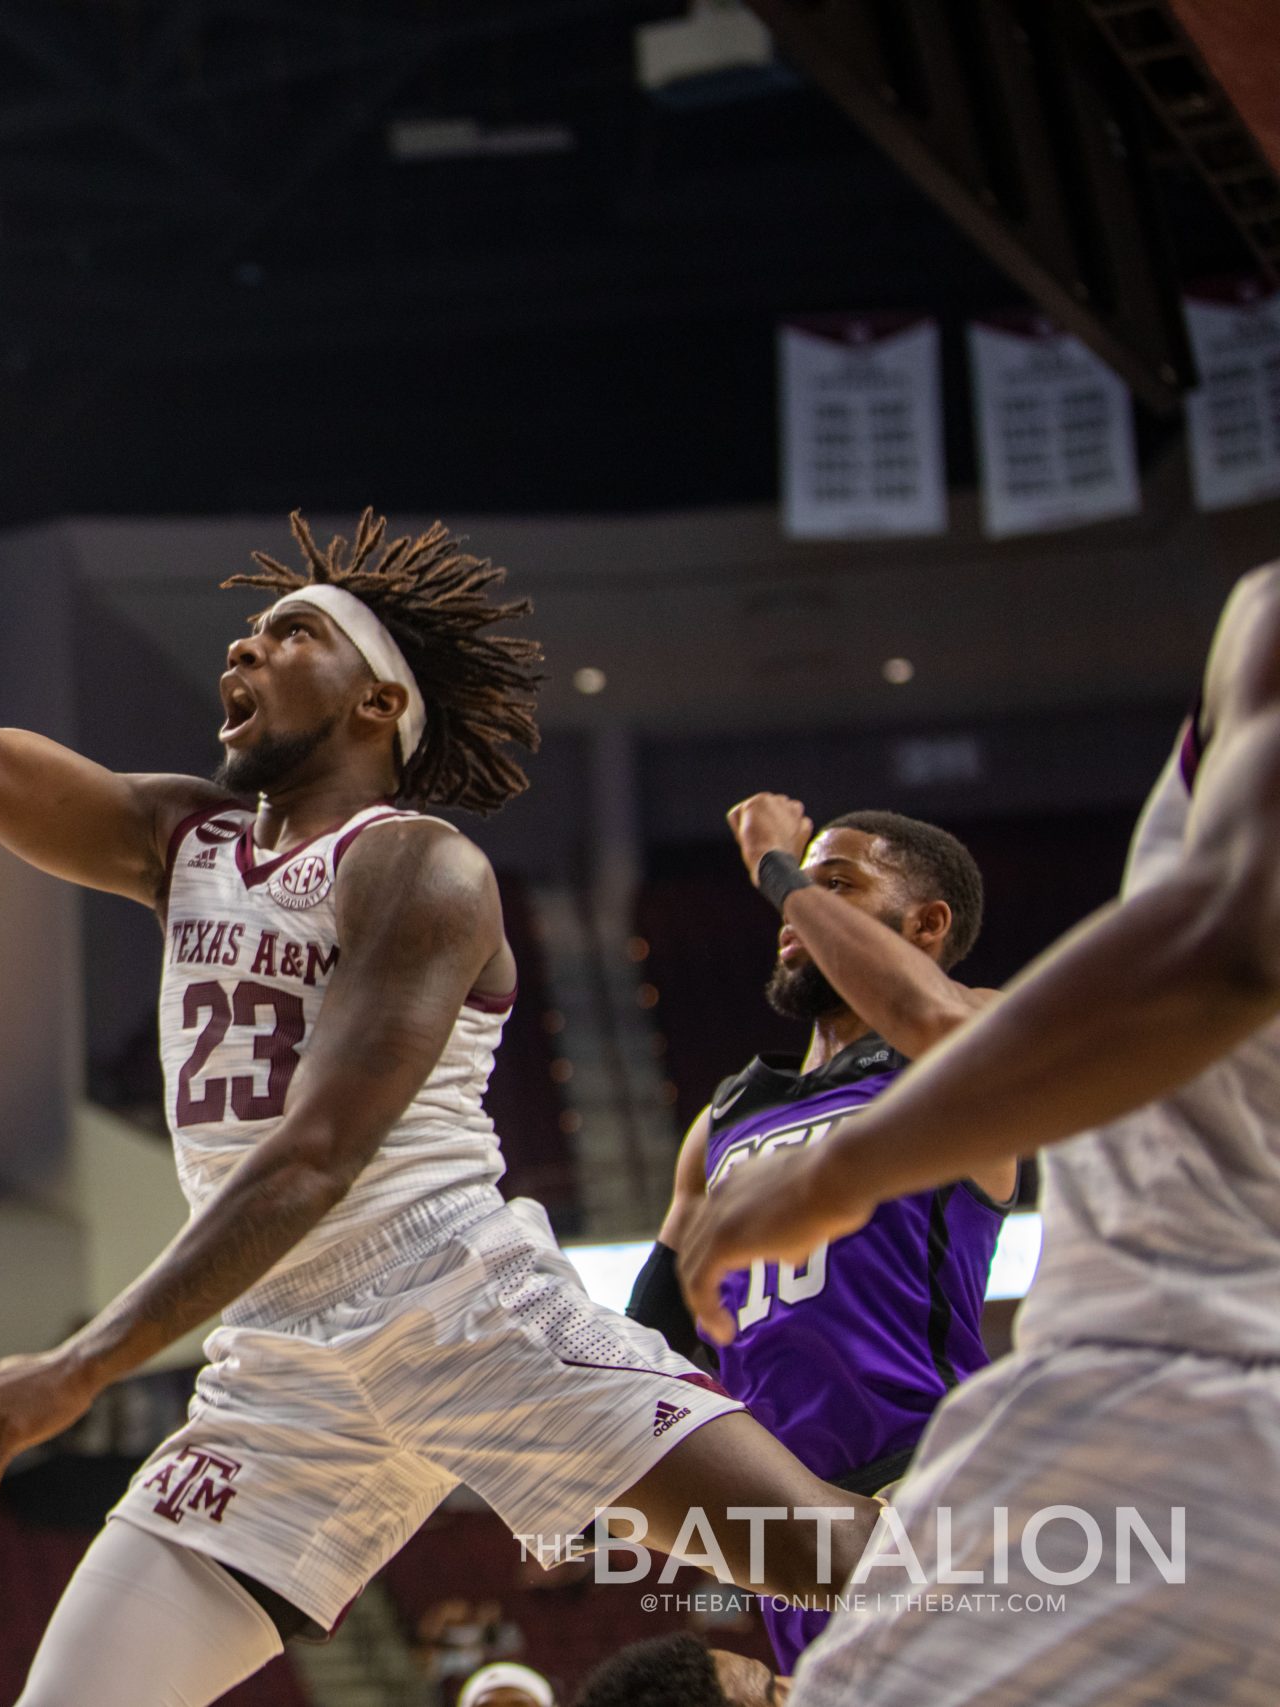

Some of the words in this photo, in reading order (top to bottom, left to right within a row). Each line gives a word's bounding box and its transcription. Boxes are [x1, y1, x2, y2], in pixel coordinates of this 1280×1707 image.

[187, 859, 216, 869] adidas
[283, 857, 325, 894] SEC
[171, 920, 245, 966] TEXAS
[250, 929, 341, 986] A&M
[176, 980, 307, 1128] 23
[653, 1407, 692, 1437] adidas
